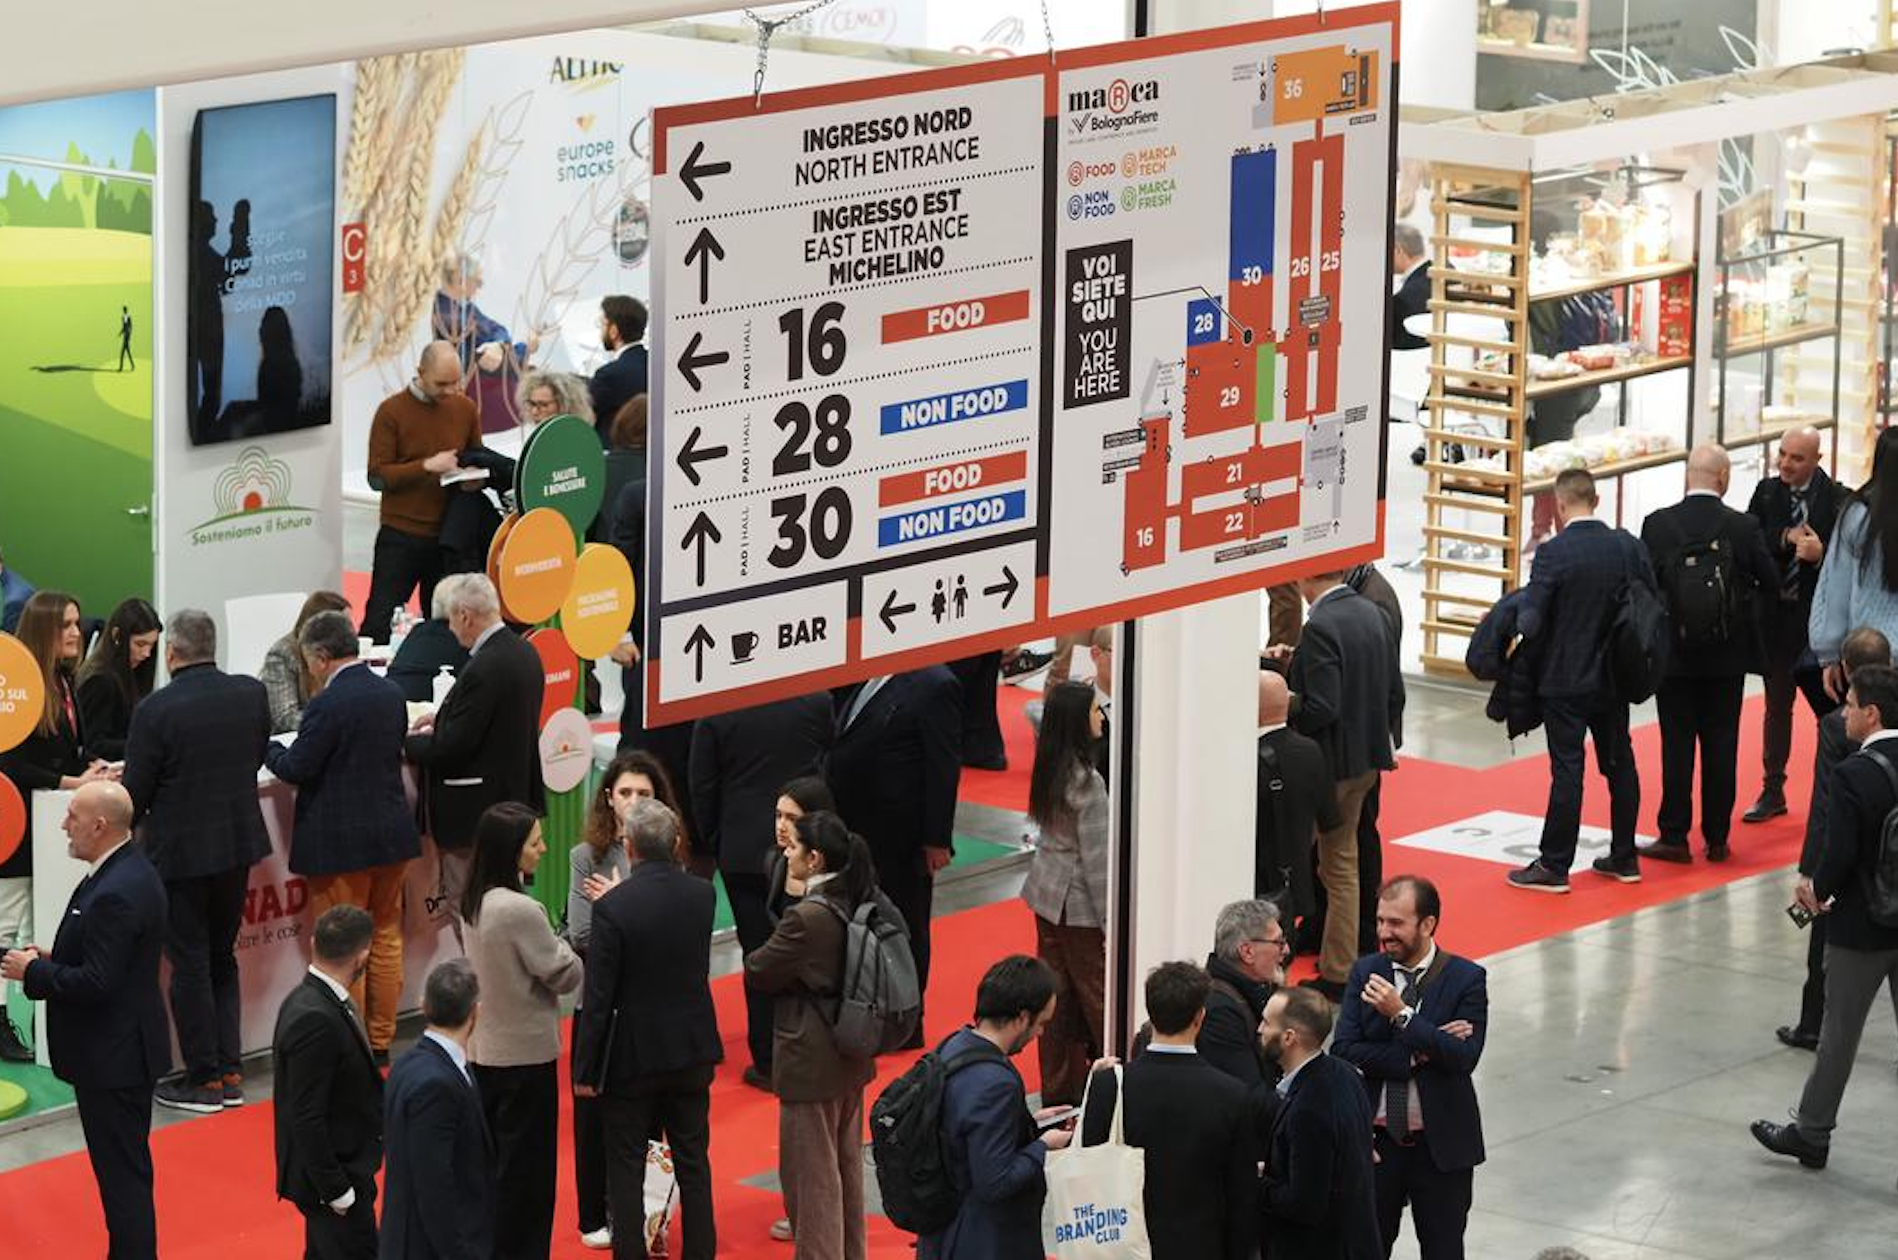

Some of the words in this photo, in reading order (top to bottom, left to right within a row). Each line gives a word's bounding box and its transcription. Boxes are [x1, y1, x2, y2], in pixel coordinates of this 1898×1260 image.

[1283, 78, 1303, 99] 36
[803, 115, 909, 153] INGRESSO
[914, 107, 972, 133] NORD
[1091, 111, 1159, 131] BolognaFiere
[557, 140, 615, 162] europe
[795, 154, 867, 187] NORTH
[873, 137, 979, 174] ENTRANCE
[1139, 145, 1177, 162] MARCA
[556, 159, 615, 182] snacks
[1086, 163, 1116, 178] FOOD
[1139, 162, 1167, 176] TECH
[1085, 190, 1109, 204] NON
[1138, 179, 1177, 195] MARCA
[813, 196, 917, 234] INGRESSO
[923, 189, 961, 213] EST
[1084, 204, 1116, 219] FOOD
[1138, 194, 1172, 210] FRESH
[344, 228, 364, 262] C
[804, 235, 857, 262] EAST
[862, 214, 969, 253] ENTRANCE
[829, 246, 944, 286] MICHELINO
[1082, 254, 1117, 278] VOI
[1292, 258, 1310, 278] 26
[1321, 251, 1340, 273] 25
[1072, 275, 1126, 302] SIETE
[1241, 266, 1263, 287] 30
[927, 302, 985, 332] FOOD
[1081, 299, 1116, 324] QUI
[1194, 313, 1213, 335] 28
[743, 319, 752, 353] HALL
[779, 302, 847, 381] 16
[1079, 327, 1118, 351] YOU
[743, 362, 751, 389] PAD
[1079, 351, 1117, 376] ARE
[1074, 371, 1120, 399] HERE
[1220, 387, 1240, 408] 29
[901, 400, 946, 428] NON
[951, 387, 1009, 415] FOOD
[742, 413, 751, 447] HALL
[772, 394, 852, 477] 28
[742, 456, 750, 483] PAD
[925, 464, 982, 495] FOOD
[1226, 463, 1242, 483] 21
[191, 524, 262, 546] Sosteniamo
[276, 515, 312, 532] futuro
[741, 506, 750, 540] HALL
[767, 487, 853, 569] 30
[898, 512, 944, 540] NON
[949, 498, 1005, 528] FOOD
[1225, 512, 1243, 533] 22
[1136, 527, 1154, 548] 16
[740, 549, 749, 576] PAD
[778, 616, 827, 649] BAR
[7, 688, 28, 701] SUL
[242, 878, 309, 926] NAD
[1073, 1203, 1095, 1220] THE
[1055, 1208, 1128, 1243] BRANDING
[1095, 1228, 1121, 1245] CLUB
